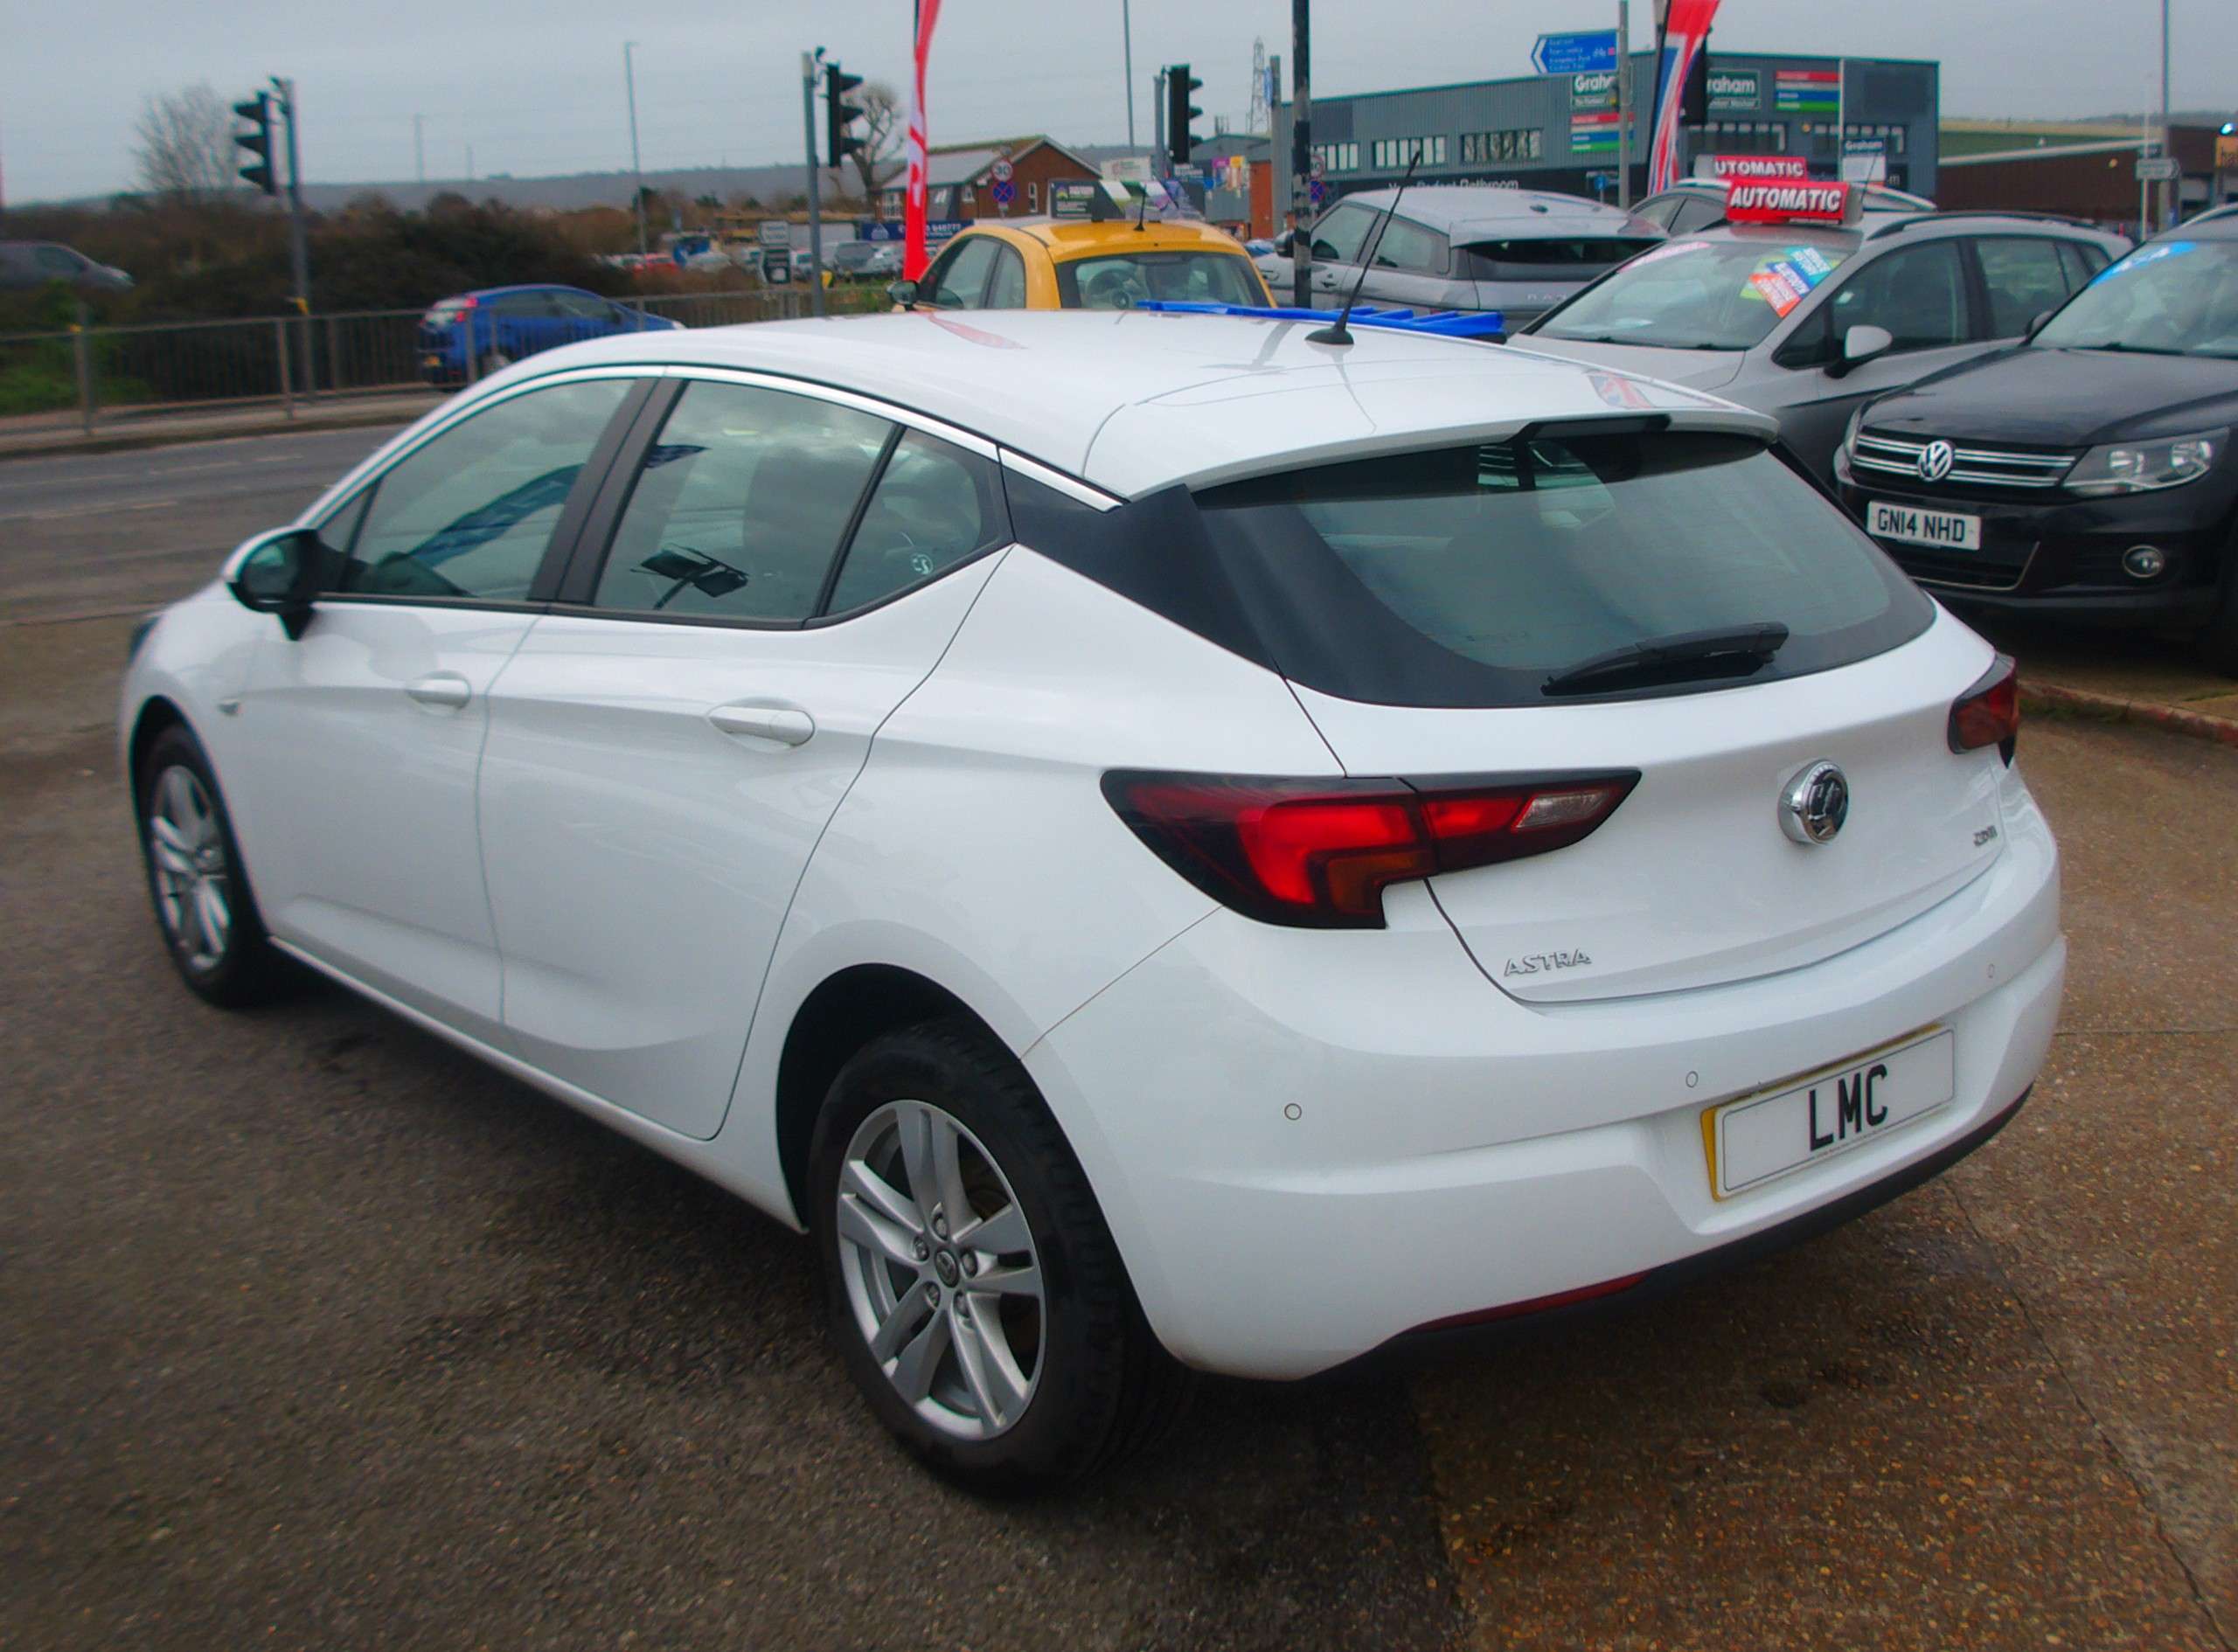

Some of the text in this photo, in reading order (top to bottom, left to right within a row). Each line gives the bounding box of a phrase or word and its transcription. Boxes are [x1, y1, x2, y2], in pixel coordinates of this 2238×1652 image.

[1706, 75, 1755, 94] raham
[1730, 186, 1841, 212] AUTOMATIC
[1877, 508, 1966, 543] GN14 NHD
[1504, 948, 1593, 977] ASTRA
[1809, 1063, 1888, 1151] LMC
